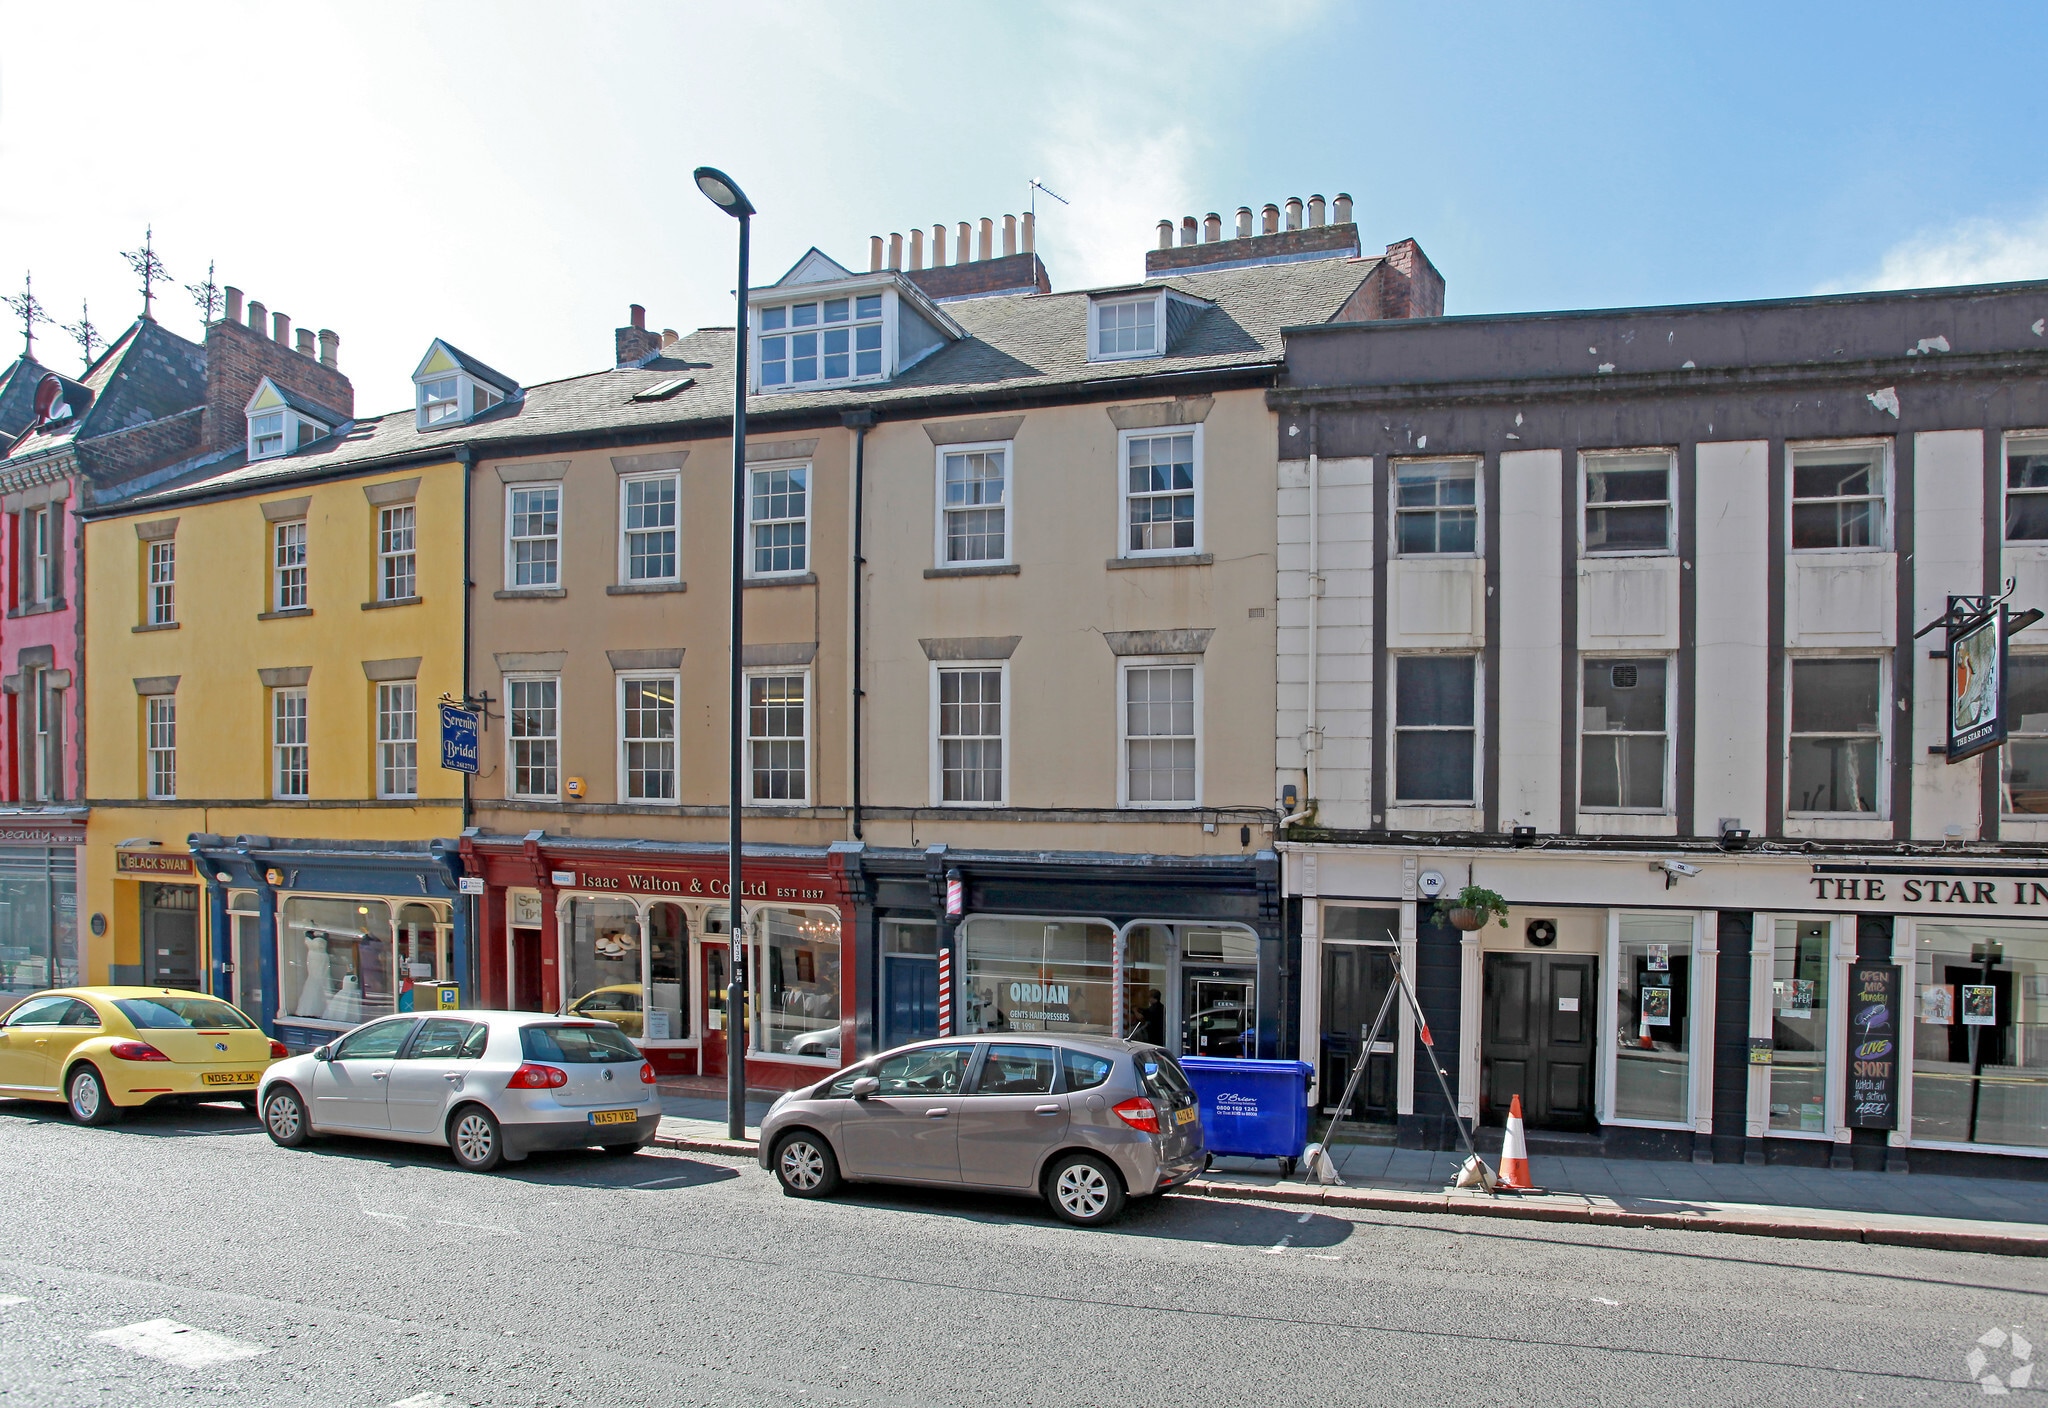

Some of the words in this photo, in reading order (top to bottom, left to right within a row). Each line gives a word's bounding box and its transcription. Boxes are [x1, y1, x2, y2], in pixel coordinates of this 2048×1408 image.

[443, 710, 477, 736] Serenity
[1956, 736, 1967, 747] THE
[1968, 730, 1980, 742] STAR
[1982, 725, 1993, 736] INN
[444, 740, 476, 759] Bridal
[129, 857, 158, 869] BLACK
[160, 858, 187, 870] SWAN
[582, 872, 618, 888] Isaac
[628, 875, 680, 892] Walton
[689, 878, 702, 893] &
[740, 880, 766, 896] Ltd
[777, 888, 797, 898] EST
[802, 889, 824, 899] 1887
[1810, 878, 1886, 900] THE
[1903, 879, 1998, 904] STAR
[1860, 971, 1889, 982] OPEN
[1010, 982, 1069, 1004] ORDIAN
[1864, 982, 1886, 992] MIC
[444, 991, 452, 1002] P
[1858, 992, 1888, 1005] Thursday
[1010, 1010, 1028, 1018] GENTS
[1030, 1012, 1070, 1021] HAIRDRESSERS
[1010, 1022, 1020, 1030] EST.
[1860, 1040, 1888, 1056] LIVE
[1854, 1062, 1892, 1078] SPORT
[208, 1074, 234, 1082] ND62
[236, 1073, 255, 1081] XJK
[1855, 1080, 1874, 1090] Watch
[1874, 1080, 1885, 1090] all
[1217, 1093, 1257, 1102] O'Brien
[1854, 1090, 1863, 1101] the
[1866, 1091, 1887, 1101] action
[1855, 1103, 1890, 1116] HERE!
[594, 1112, 617, 1123] NA57
[619, 1112, 635, 1121] VBZ
